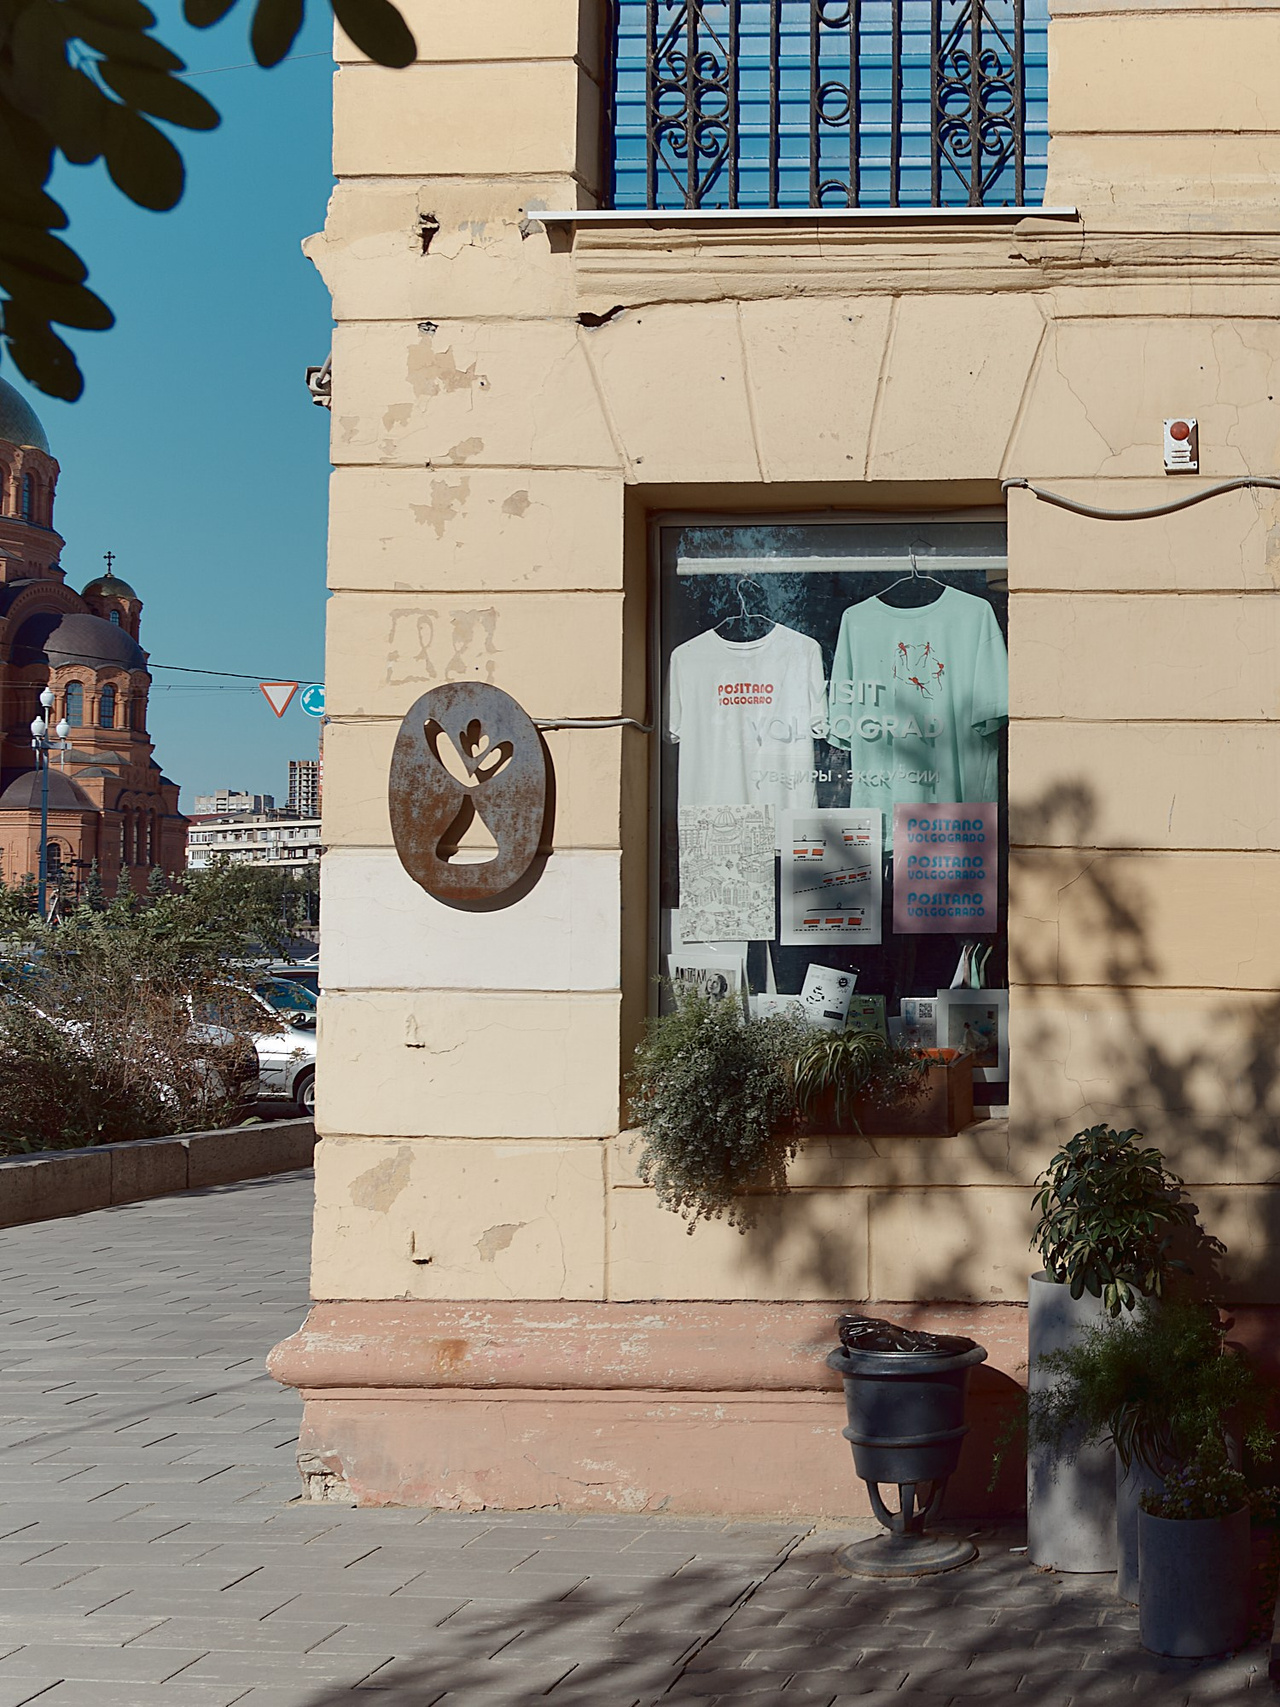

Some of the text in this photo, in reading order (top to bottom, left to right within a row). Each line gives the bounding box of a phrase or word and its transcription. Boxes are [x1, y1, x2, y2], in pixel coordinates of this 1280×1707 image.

[808, 680, 882, 706] VISIT
[747, 714, 944, 740] VOLGOGRAD
[749, 769, 941, 783] СУВЕНИРЫ ЭКСКУРСИИ
[907, 818, 984, 831] POSITANO
[907, 833, 986, 843] VOLGOGRADO
[907, 855, 984, 868] POSITANO
[907, 870, 986, 880] VOLGOGRADO
[907, 892, 984, 905] POSITANO
[907, 907, 986, 918] VOLGOGRADO
